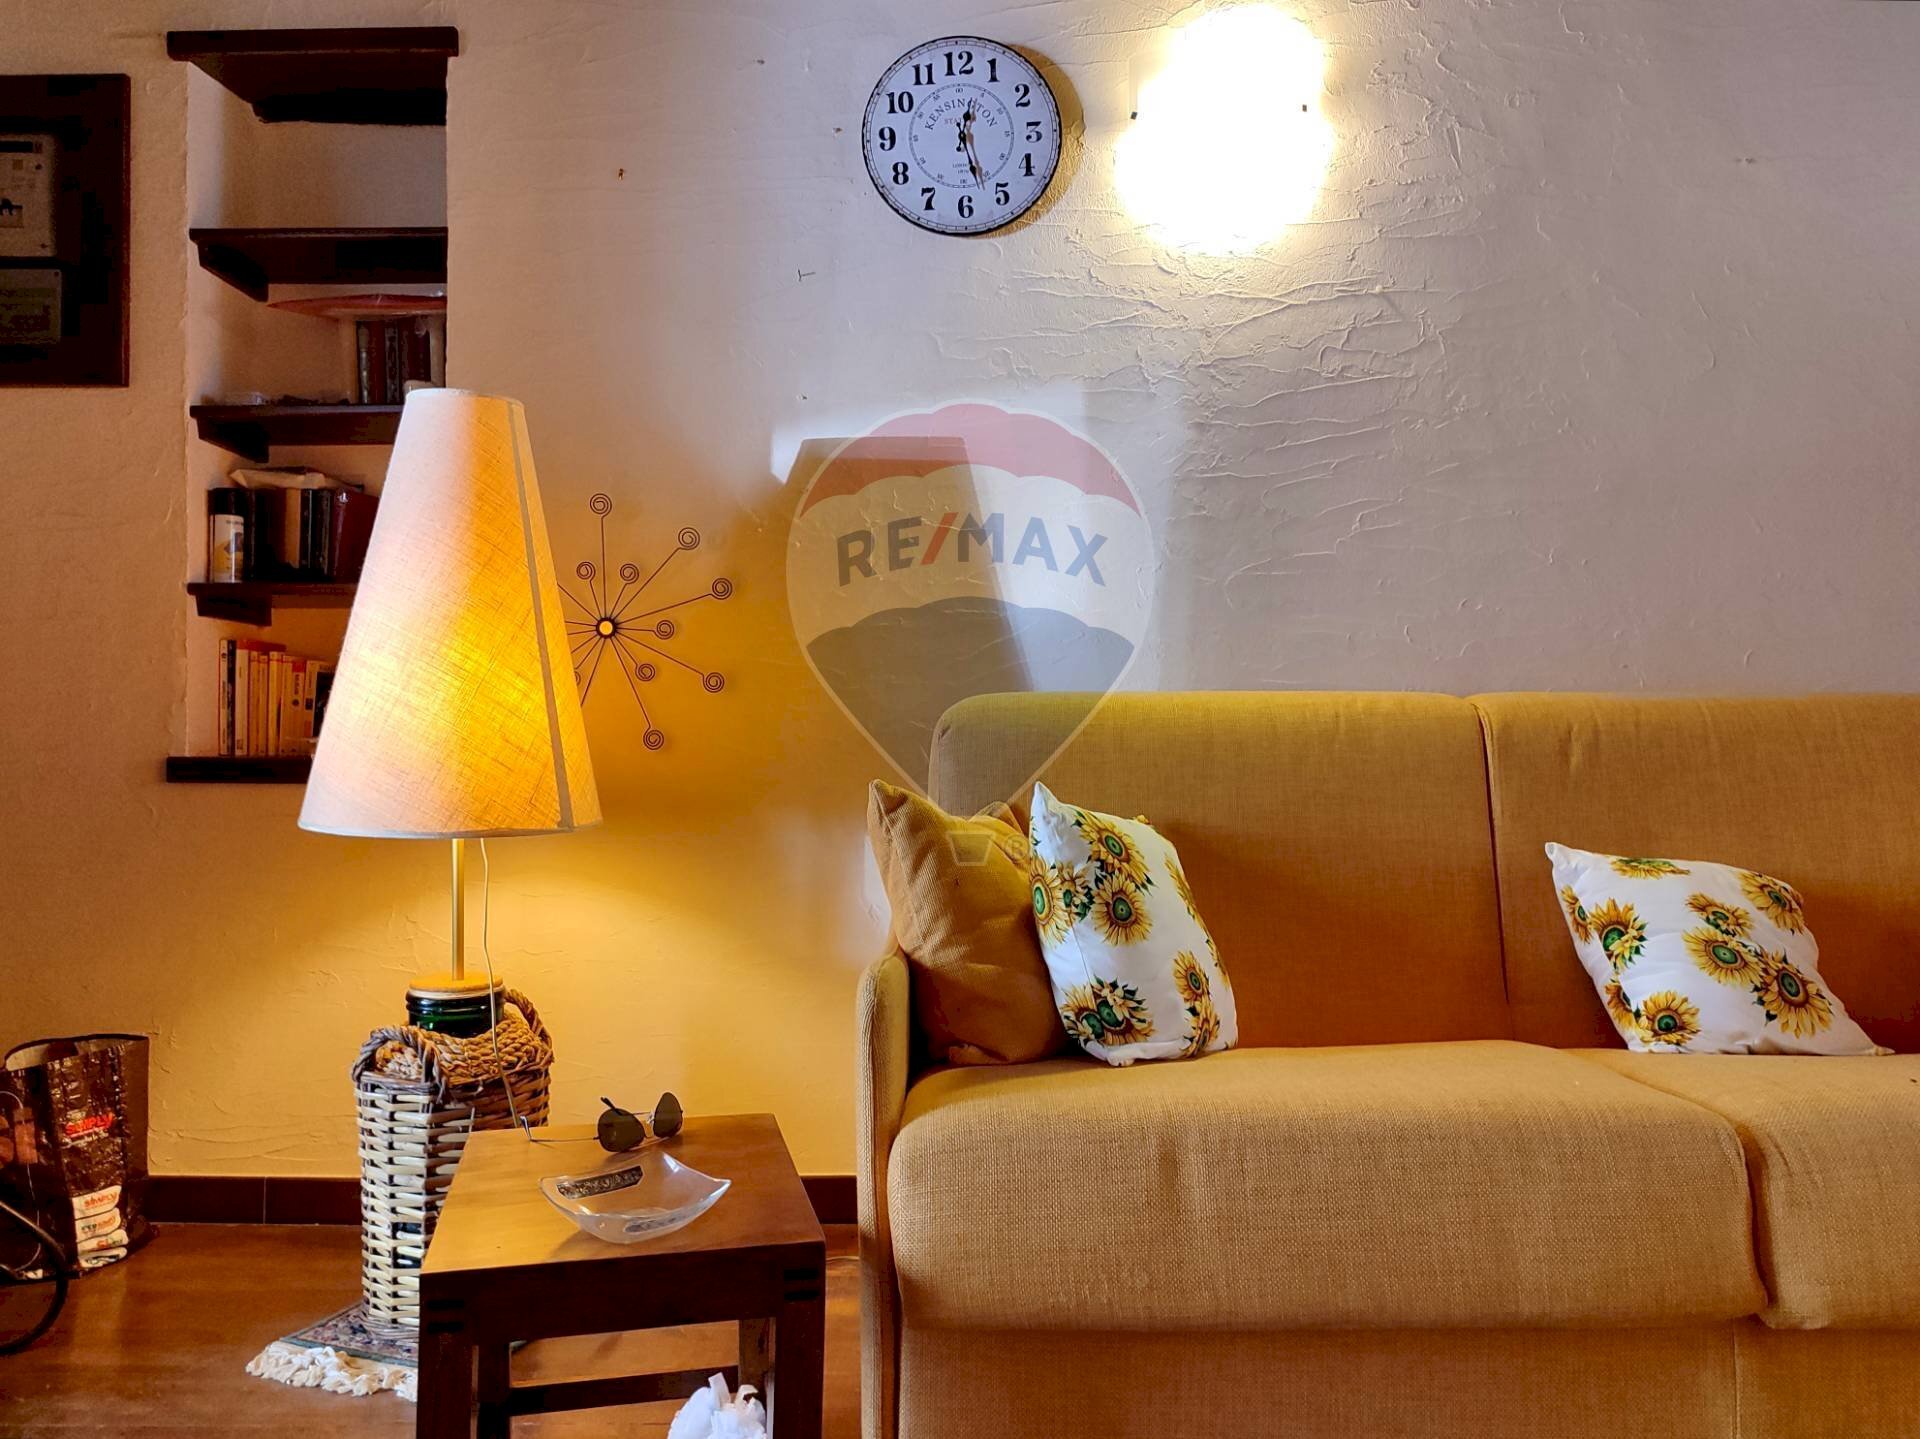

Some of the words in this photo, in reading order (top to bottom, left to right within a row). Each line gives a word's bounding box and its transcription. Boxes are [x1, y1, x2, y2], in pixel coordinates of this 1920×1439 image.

[911, 63, 936, 86] 11
[944, 51, 975, 77] 12
[987, 58, 1000, 83] 1
[885, 91, 914, 115] 10
[1014, 84, 1031, 108] 2
[878, 126, 897, 152] 9
[1025, 121, 1043, 144] 3
[892, 161, 909, 186] 8
[1018, 153, 1036, 177] 4
[921, 187, 936, 211] 7
[994, 182, 1010, 206] 5
[957, 195, 974, 219] 6
